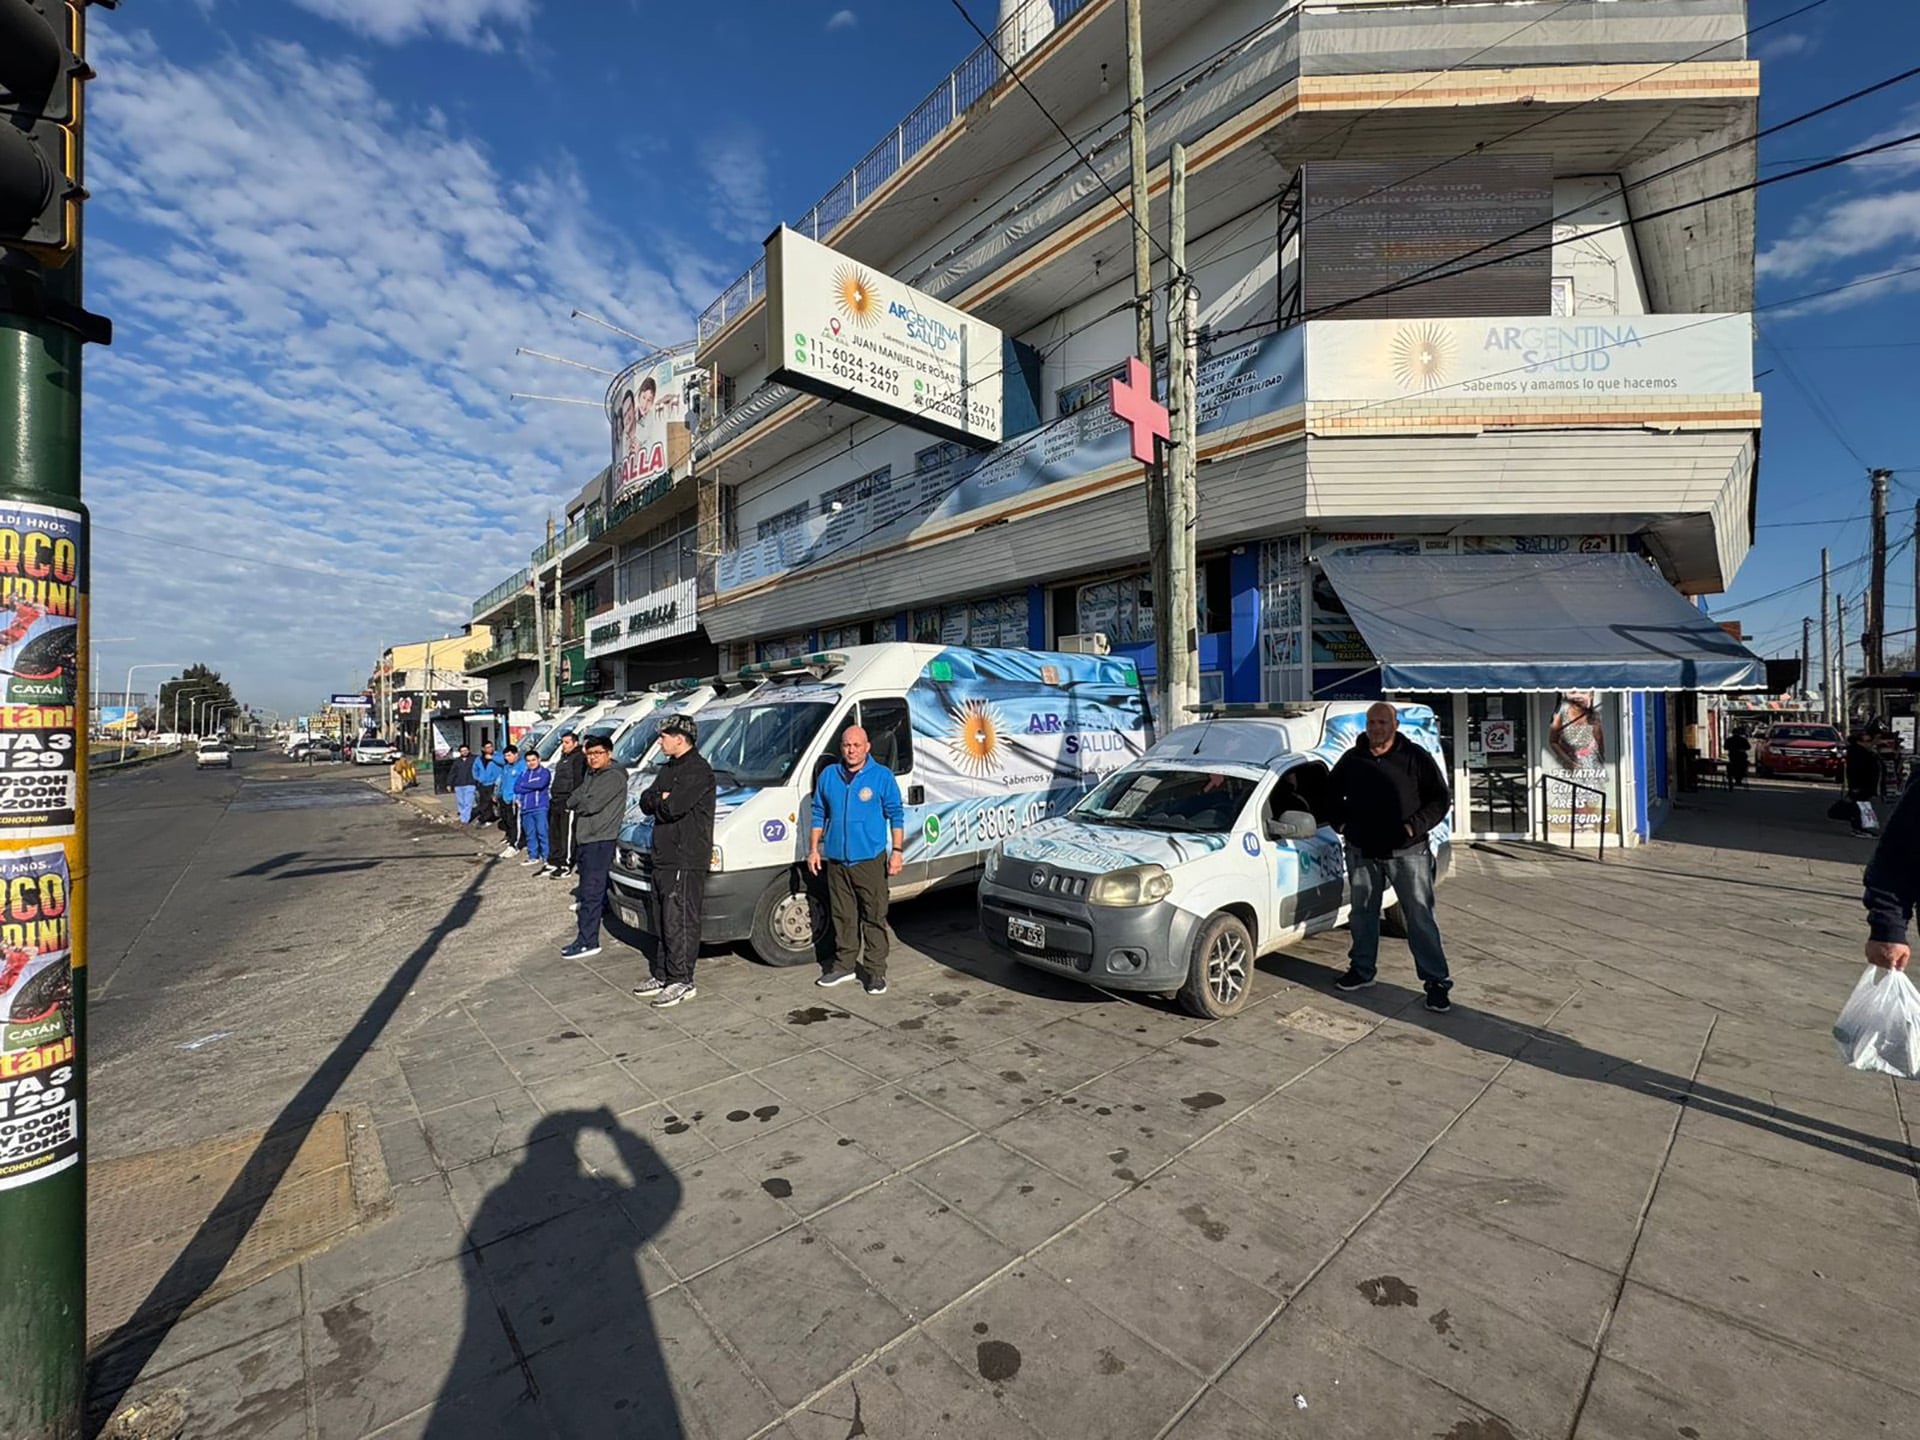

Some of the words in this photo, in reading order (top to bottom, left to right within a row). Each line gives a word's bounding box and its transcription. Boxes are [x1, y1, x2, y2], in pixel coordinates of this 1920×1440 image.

[888, 301, 960, 344] ARGENTINA
[907, 323, 947, 350] SALUD
[1484, 326, 1642, 350] ARGENTINA
[811, 338, 899, 381] 11-6024-2469
[852, 335, 877, 352] JUAN
[878, 345, 915, 368] MANUEL
[916, 360, 927, 373] DE
[928, 365, 955, 384] ROSAS
[1522, 350, 1611, 373] SALUD
[811, 353, 899, 396] 11-6024-2470
[1463, 379, 1517, 391] Sabemos
[1520, 381, 1527, 392] y
[1531, 380, 1579, 390] amamos
[1583, 378, 1594, 389] lo
[1599, 380, 1620, 392] que
[1624, 378, 1678, 389] hacemos
[26, 517, 70, 534] HNOS.
[1515, 535, 1569, 552] SALUD
[11, 684, 63, 695] CATÁN
[48, 733, 72, 750] 3
[1066, 734, 1124, 754] SALUD
[12, 751, 64, 768] 29
[1002, 773, 1043, 786] Sabemos
[14, 787, 66, 798] DOM
[766, 825, 782, 837] 27
[977, 806, 1017, 841] 3805
[1247, 836, 1258, 851] 10
[8, 1022, 61, 1040] CATÁN
[50, 1066, 72, 1086] 3
[14, 1086, 66, 1115] 29
[19, 1118, 70, 1144] DOM
